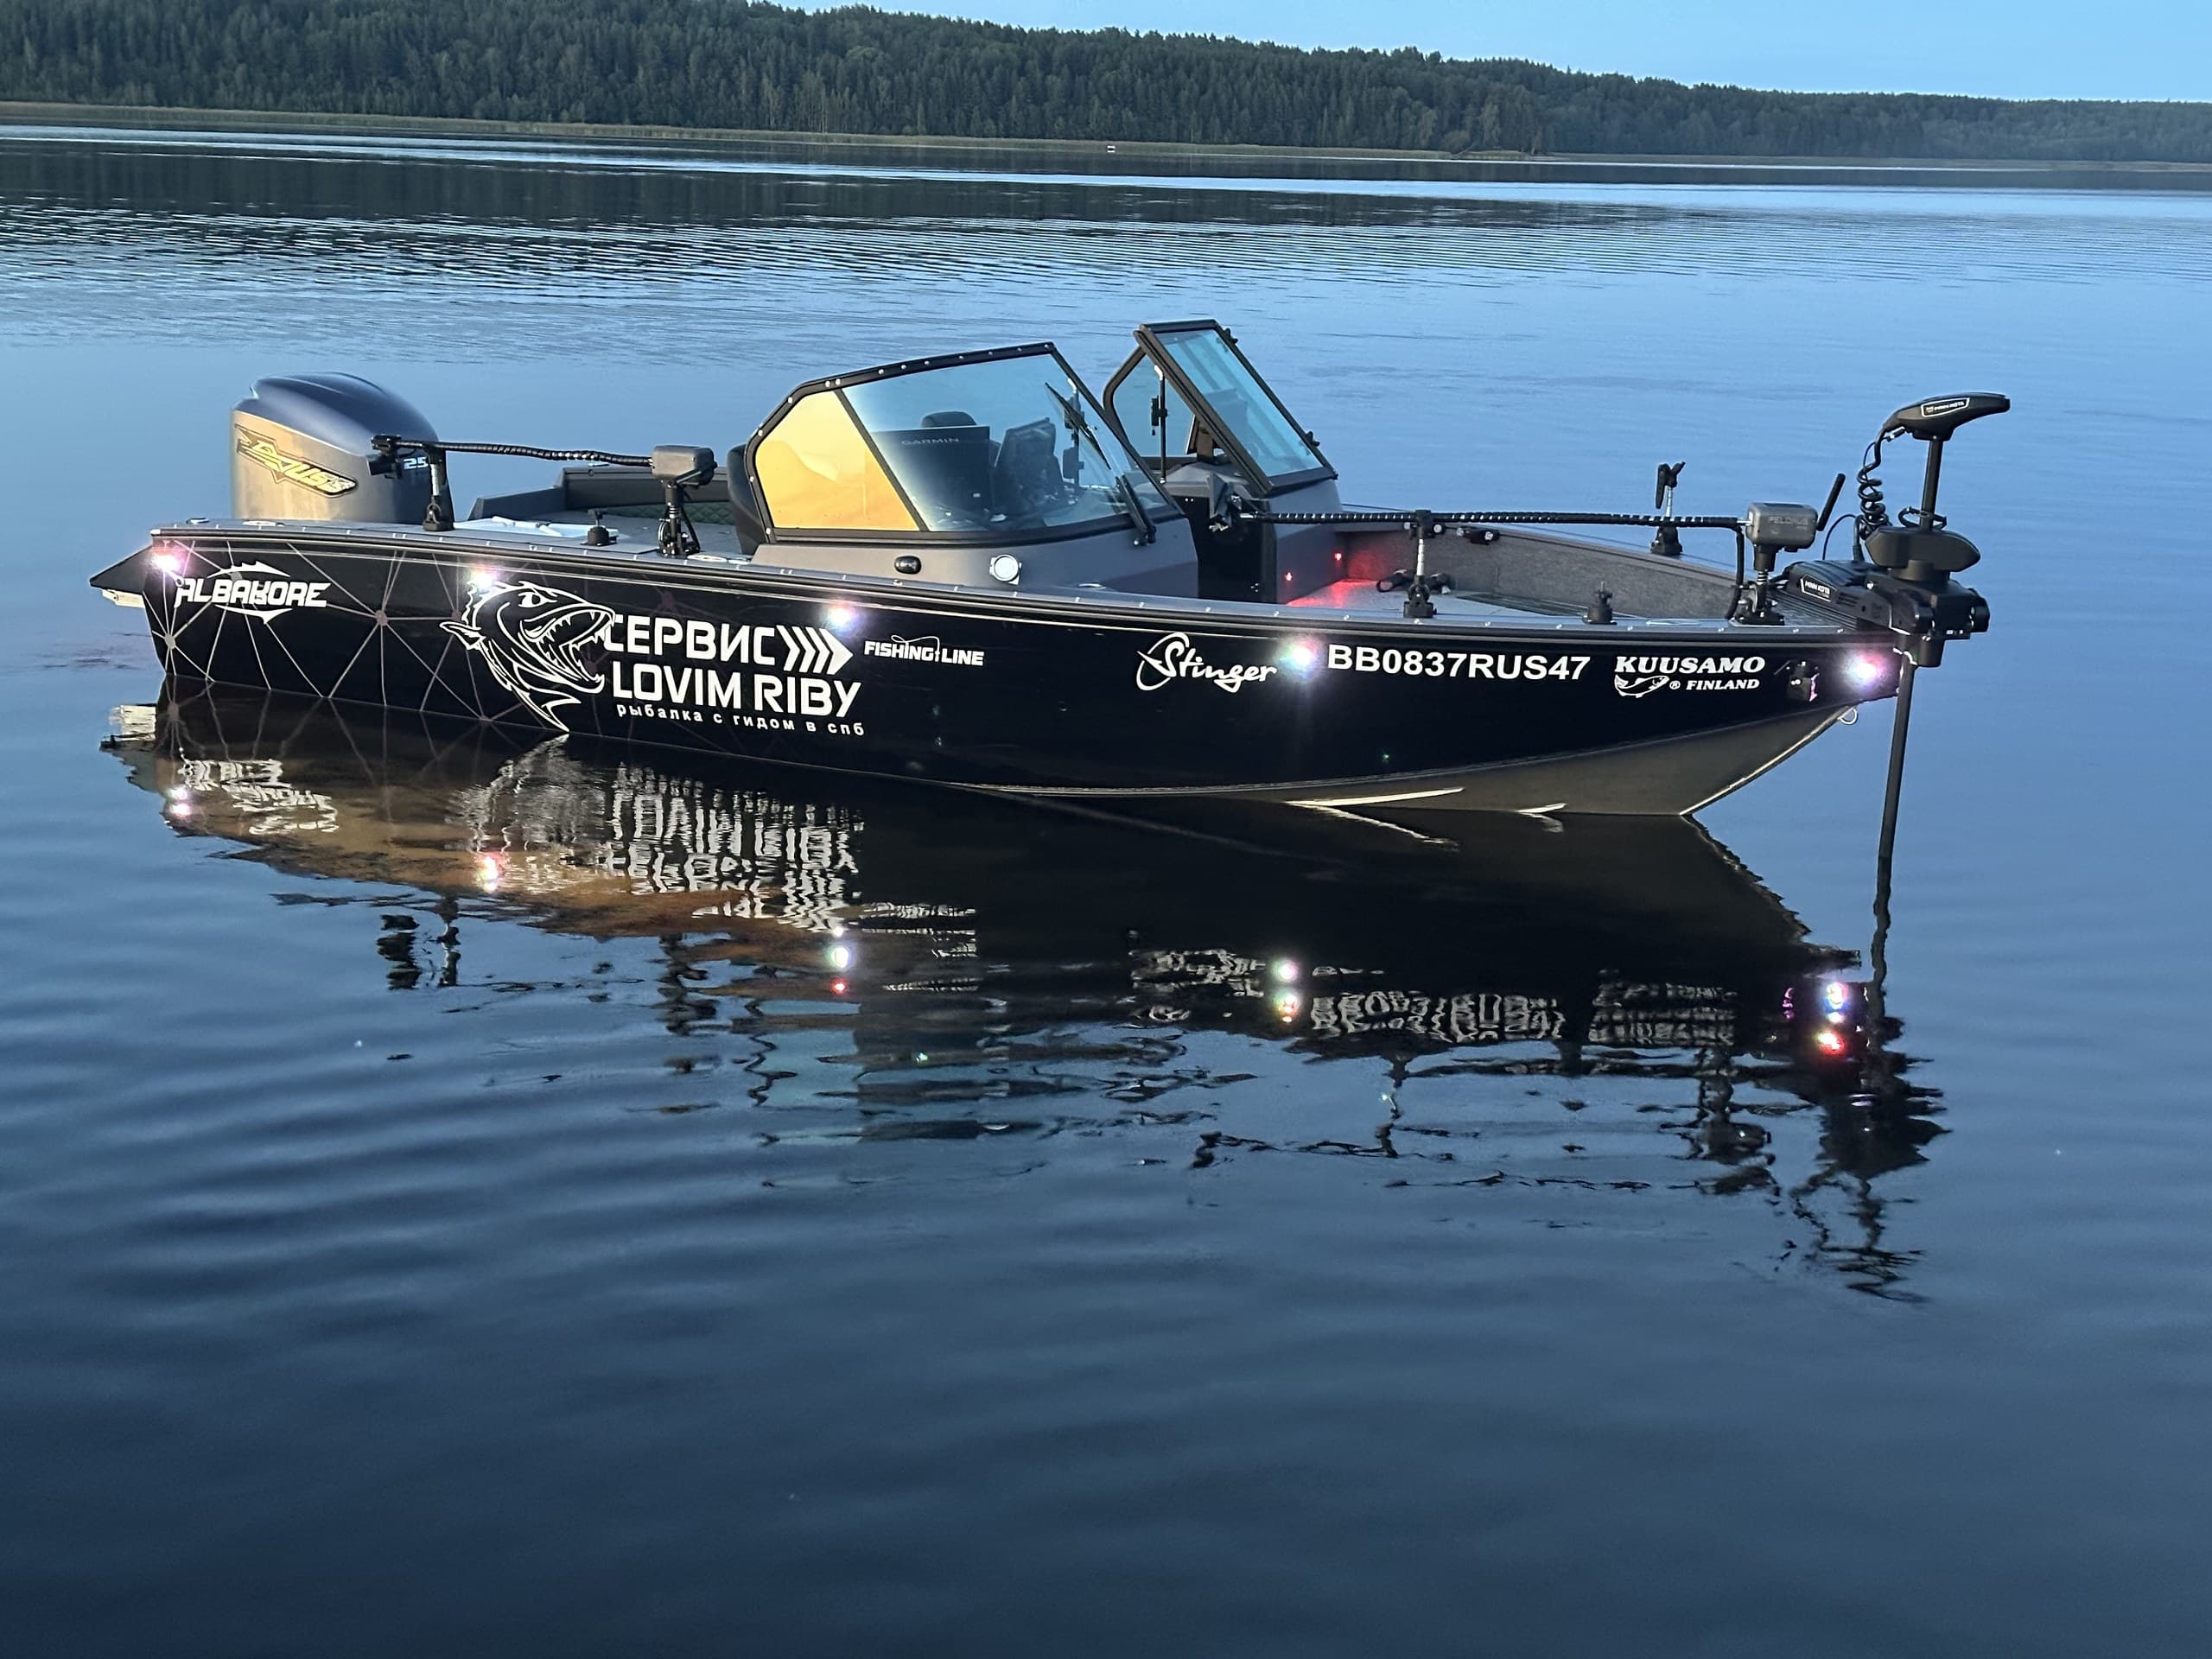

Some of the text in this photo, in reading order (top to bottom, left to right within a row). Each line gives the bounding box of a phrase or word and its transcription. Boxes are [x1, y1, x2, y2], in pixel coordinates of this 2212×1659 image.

[901, 437, 959, 446] GARMIN
[604, 613, 775, 666] СЕРВИС
[864, 640, 985, 666] FISHING LINE
[1137, 638, 1277, 693] Stinger
[1328, 644, 1591, 680] BB0837RUS47
[1614, 656, 1765, 674] KUUSAMO
[613, 661, 861, 718] LOVIM RIBY
[1686, 679, 1760, 690] FINLAND
[616, 703, 864, 736] рыбалка с гидом в спб
